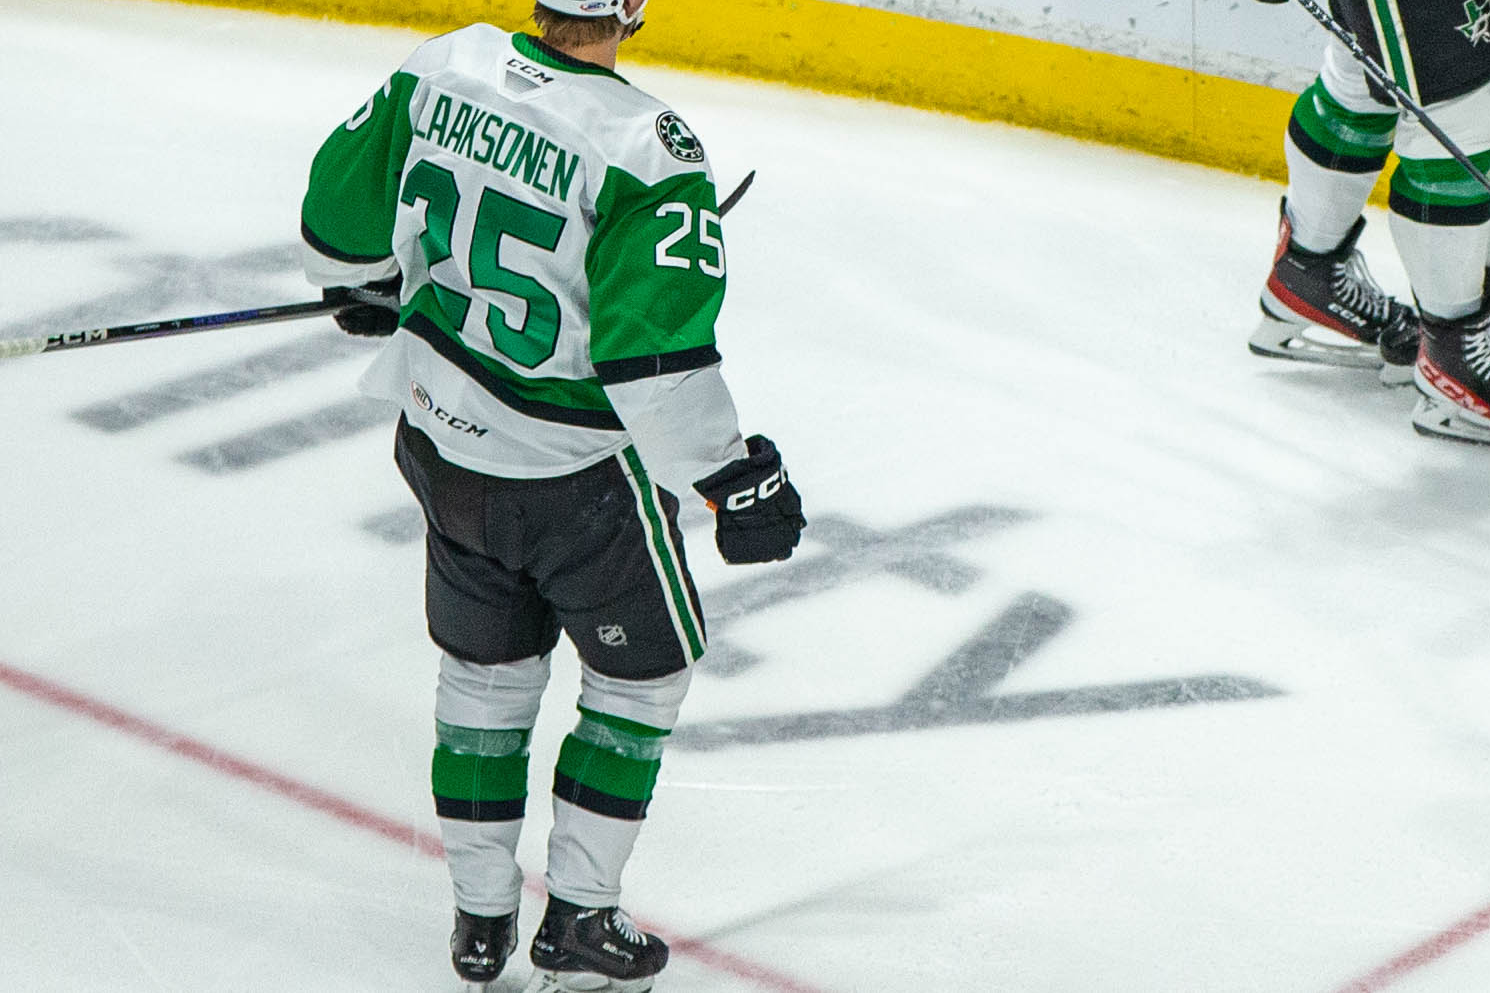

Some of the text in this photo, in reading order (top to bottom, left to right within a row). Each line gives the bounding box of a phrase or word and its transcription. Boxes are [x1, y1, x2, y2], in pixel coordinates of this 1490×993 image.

[506, 59, 555, 84] CCM
[400, 157, 568, 370] 25
[655, 201, 726, 280] 25
[434, 407, 489, 439] CCM
[726, 464, 788, 512] CC
